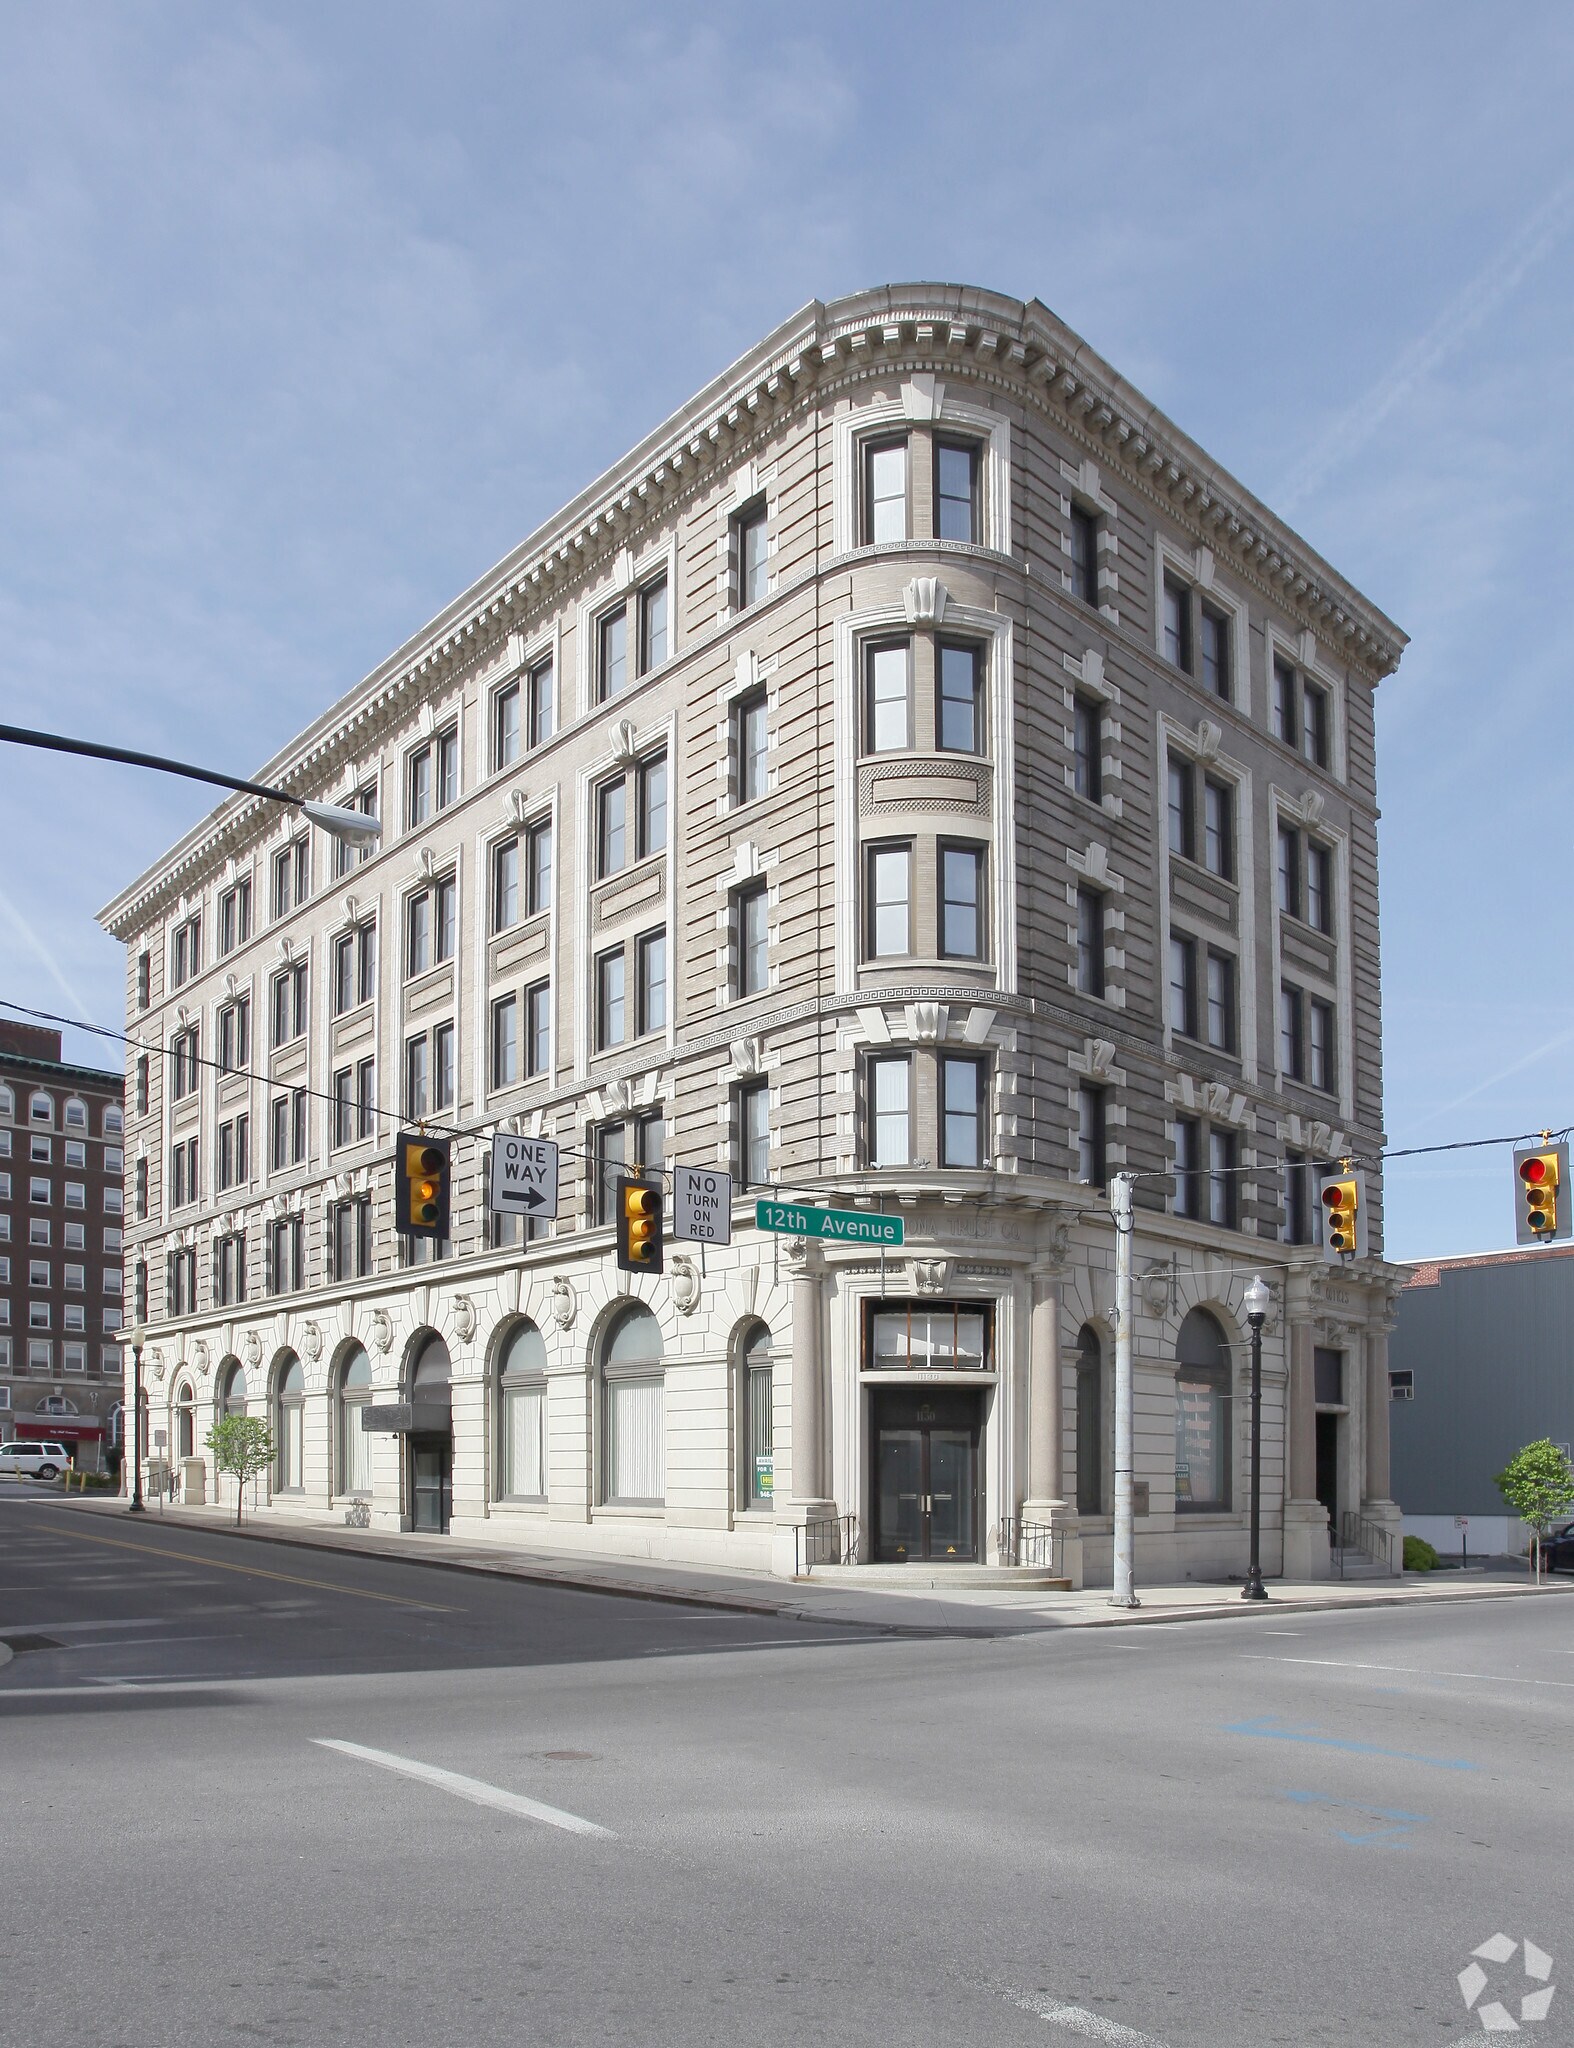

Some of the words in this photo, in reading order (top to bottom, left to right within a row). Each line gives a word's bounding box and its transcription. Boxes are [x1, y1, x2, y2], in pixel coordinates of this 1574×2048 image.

[506, 1142, 547, 1164] ONE
[505, 1163, 548, 1184] WAY
[689, 1174, 717, 1194] NO
[686, 1193, 719, 1209] TURN
[694, 1209, 711, 1223] ON
[765, 1208, 807, 1230] 12th
[821, 1215, 895, 1239] Avenue
[690, 1224, 715, 1238] RED
[904, 1216, 938, 1236] ONA
[947, 1217, 993, 1238] TRUST
